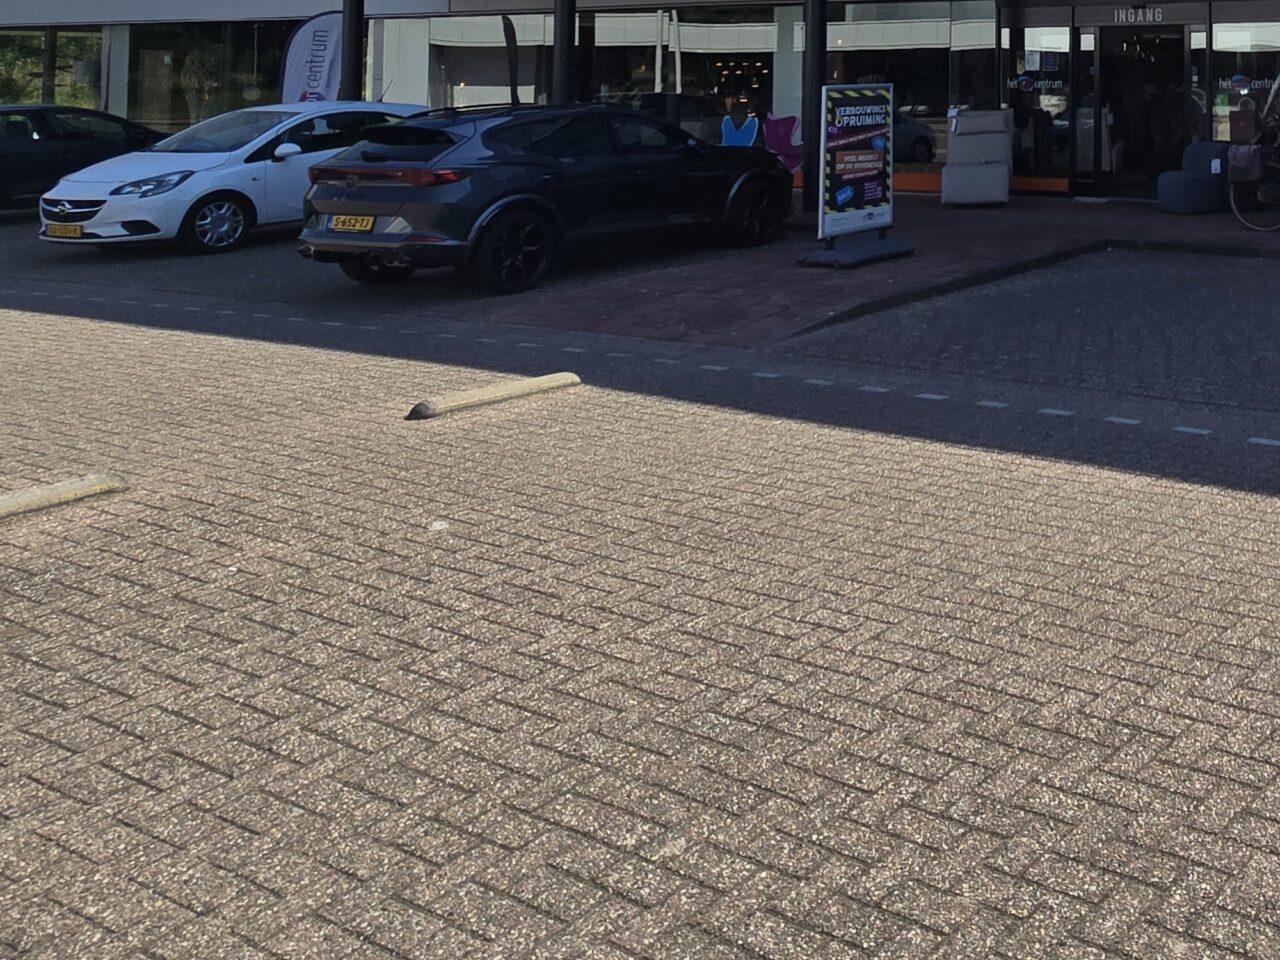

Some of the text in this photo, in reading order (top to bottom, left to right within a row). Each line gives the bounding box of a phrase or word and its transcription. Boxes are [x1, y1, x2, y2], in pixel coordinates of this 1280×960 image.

[1114, 8, 1163, 23] INGANG
[305, 29, 329, 89] centrum
[334, 217, 370, 228] S-652-TJ
